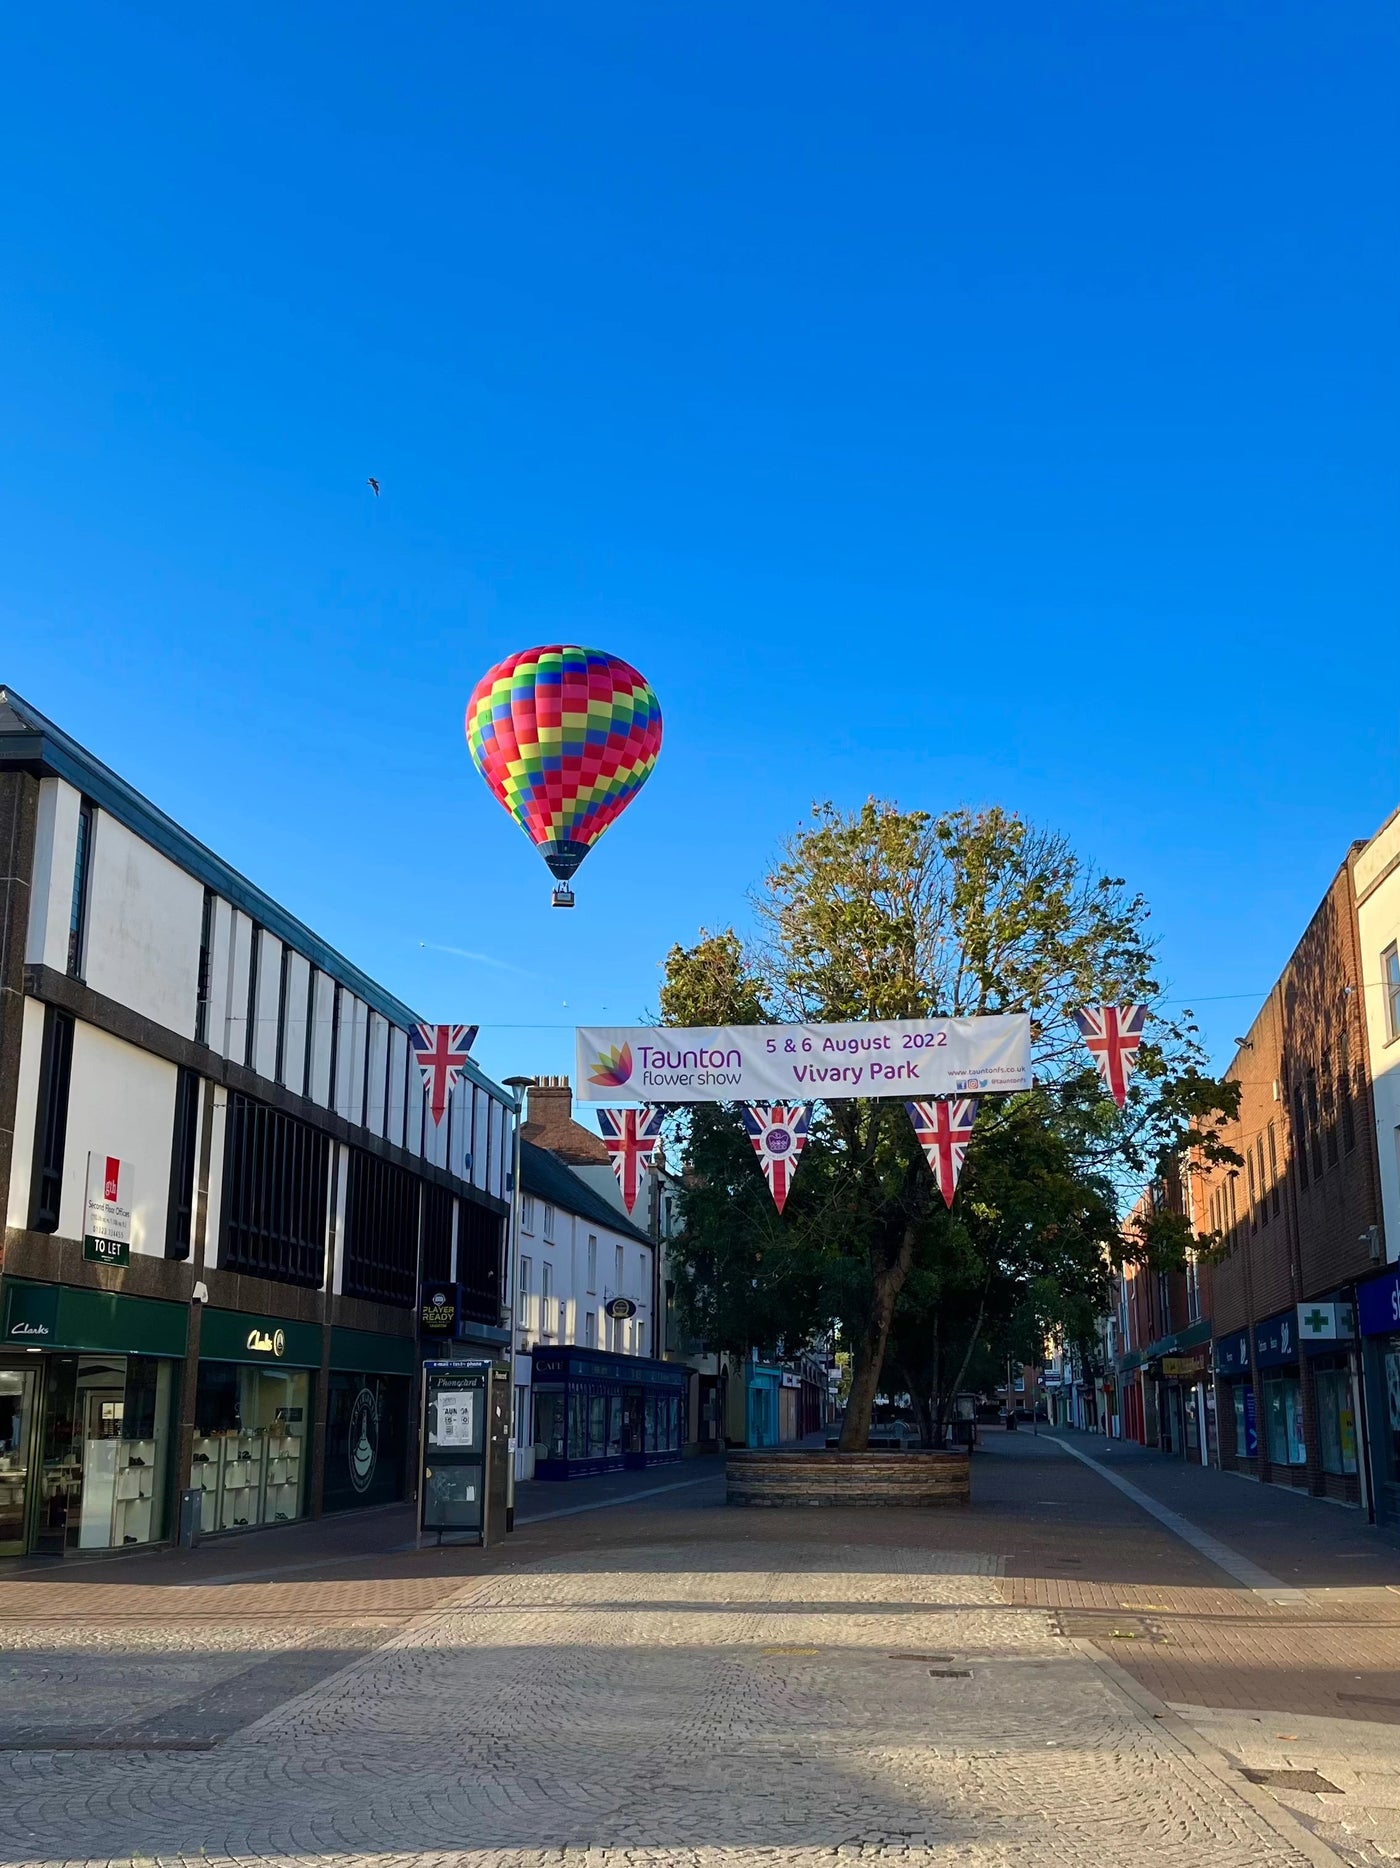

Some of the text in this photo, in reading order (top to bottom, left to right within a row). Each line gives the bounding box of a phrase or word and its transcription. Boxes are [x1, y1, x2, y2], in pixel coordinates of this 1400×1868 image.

[766, 1032, 947, 1054] 5 & 6 August 2022
[638, 1047, 742, 1069] Taunton
[793, 1060, 920, 1085] Vivary Park
[947, 1066, 1026, 1076] www.tauntonfs.co.uk
[643, 1071, 742, 1086] flower show
[88, 1199, 104, 1211] Second
[94, 1239, 121, 1256] TO LET
[422, 1313, 455, 1321] READY
[11, 1322, 49, 1335] Clarks
[437, 1377, 478, 1387] Phonecard
